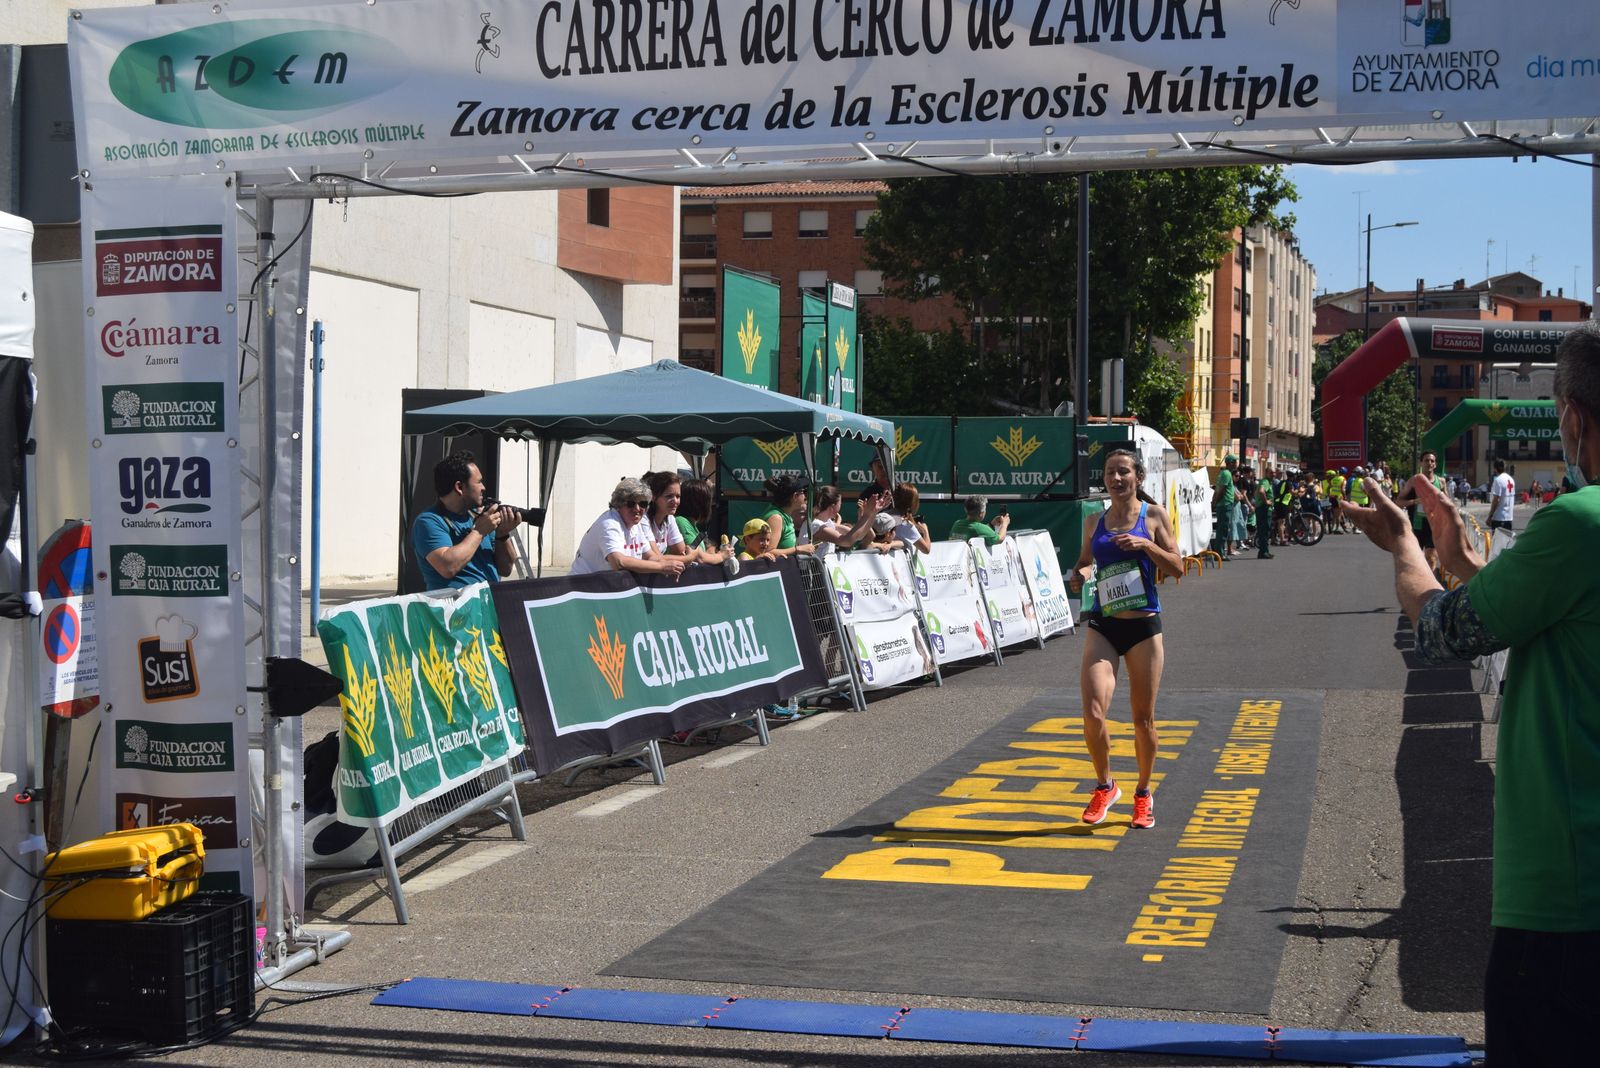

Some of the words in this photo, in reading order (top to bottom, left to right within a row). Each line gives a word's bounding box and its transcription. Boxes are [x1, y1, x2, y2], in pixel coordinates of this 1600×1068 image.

[536, 0, 727, 79] CARRERA
[740, 0, 798, 66] del
[812, 0, 951, 61] CERCO
[968, 0, 1014, 51] de
[1353, 50, 1500, 71] AYUNTAMIENTO
[1527, 55, 1564, 78] dia
[1353, 72, 1382, 92] DE
[1389, 69, 1500, 92] ZAMORA
[450, 101, 620, 137] Zamora
[632, 102, 751, 132] cerca
[764, 88, 816, 131] de
[830, 85, 872, 128] la
[885, 73, 1108, 126] Esclerosis
[1122, 63, 1319, 121] Múltiple
[104, 138, 179, 161] ASOCIACIÓN
[185, 135, 254, 155] ZAMORANA
[261, 133, 279, 150] DE
[284, 128, 359, 147] ESCLEROSIS
[365, 123, 425, 143] MÚLTIPLE
[124, 248, 193, 263] DIPUTACIÓN
[197, 249, 214, 260] DE
[123, 263, 216, 284] ZAMORA
[1493, 329, 1519, 339] CON
[1522, 330, 1537, 339] EL
[1443, 339, 1480, 348] ZAMORA
[1493, 343, 1551, 353] GANAMOS
[145, 355, 179, 366] Zamora
[142, 401, 217, 414] FUNDACION
[1510, 406, 1543, 418] CAJA
[143, 416, 166, 428] CAJA
[169, 414, 217, 426] RURAL
[1506, 428, 1562, 438] SALIDA
[731, 468, 767, 482] CAJA
[968, 471, 1007, 486] CAJA
[1010, 471, 1066, 486] RURAL
[118, 456, 212, 515] gaza
[121, 518, 161, 529] Ganaderos
[162, 518, 171, 528] de
[173, 517, 212, 529] Zamora
[147, 566, 220, 578] FUNDACION
[148, 579, 170, 591] CAJA
[172, 579, 220, 591] RURAL
[1106, 581, 1130, 601] MARÍA
[632, 629, 695, 688] CAJA
[688, 616, 769, 676] RURAL
[145, 653, 190, 687] Susi
[149, 740, 226, 754] FUNDACION
[150, 753, 174, 767] CAJA
[176, 754, 226, 767] RURAL
[1176, 788, 1261, 850] INTEGRAL
[1125, 856, 1239, 948] REFORMA
